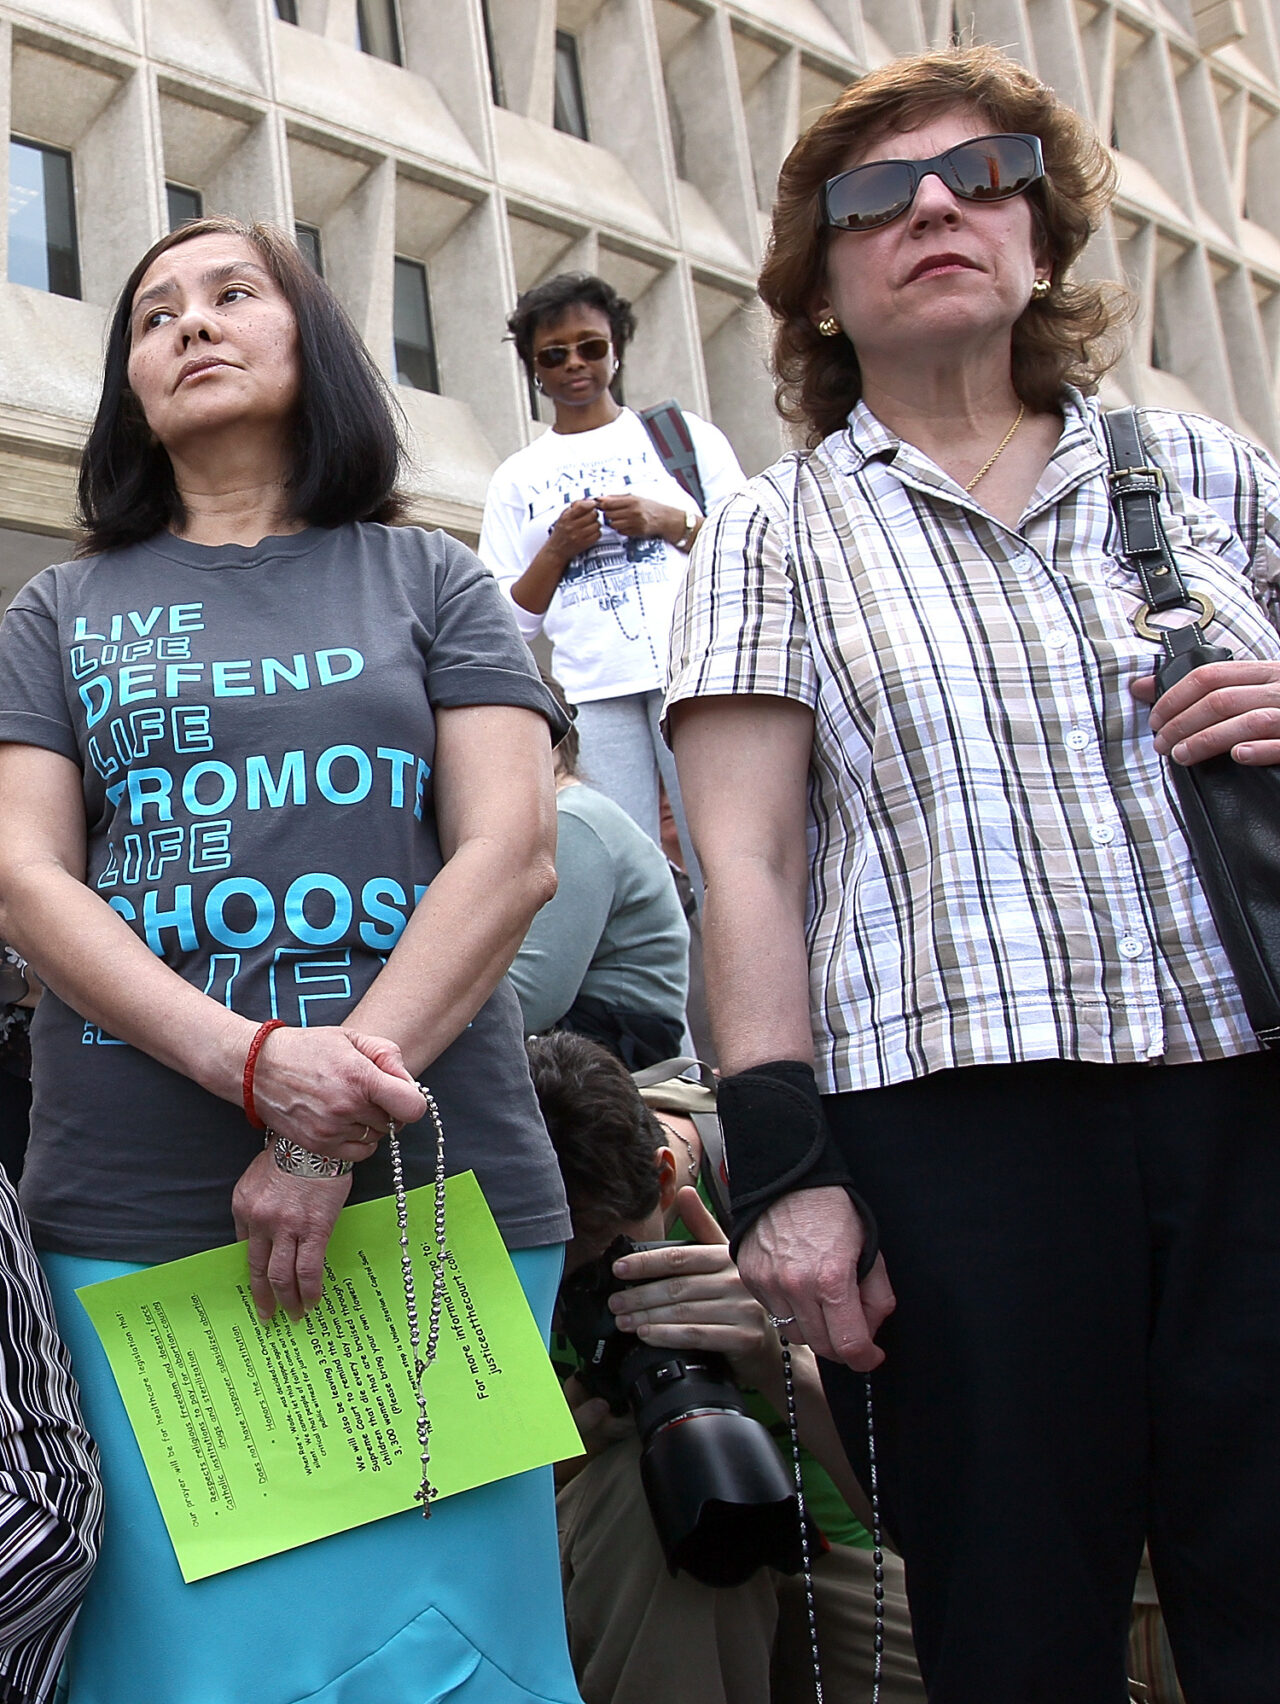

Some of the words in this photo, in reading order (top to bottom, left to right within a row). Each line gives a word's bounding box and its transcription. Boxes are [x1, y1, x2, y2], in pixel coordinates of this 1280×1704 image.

[74, 602, 205, 642] LIVE
[70, 637, 191, 680] LIFE
[78, 647, 365, 728] DEFEND
[88, 706, 214, 777] LIFE
[98, 820, 231, 889] LIFE
[358, 1250, 369, 1266] South
[420, 1242, 432, 1257] to:
[364, 1266, 378, 1288] Capitol
[332, 1284, 350, 1316] through
[342, 1278, 363, 1311] flowers)
[115, 1310, 128, 1329] that:
[140, 1304, 155, 1325] force
[241, 1295, 257, 1326] community
[379, 1298, 392, 1322] Station
[446, 1250, 502, 1375] justiceatthecourt.com
[263, 1325, 272, 1339] Tha
[276, 1328, 282, 1336] to
[284, 1324, 292, 1337] this
[314, 1306, 330, 1337] Justice
[332, 1317, 345, 1339] from
[359, 1314, 370, 1330] own
[150, 1326, 169, 1359] doesn't
[152, 1301, 186, 1368] abortion-causing
[254, 1326, 268, 1356] Christian
[278, 1338, 287, 1348] out
[290, 1338, 296, 1346] on
[345, 1319, 364, 1352] bruised
[366, 1334, 380, 1354] your
[389, 1324, 400, 1343] Union
[126, 1332, 146, 1375] legislation
[203, 1328, 229, 1373] subsidized
[232, 1323, 258, 1378] Constitution.
[284, 1349, 294, 1366] come
[293, 1347, 307, 1369] justice
[310, 1338, 327, 1365] 3,330
[327, 1340, 337, 1356] the
[342, 1342, 352, 1358] day
[462, 1344, 479, 1374] more
[162, 1362, 176, 1378] and
[278, 1360, 290, 1384] happen
[360, 1354, 370, 1370] are
[375, 1356, 388, 1380] bring
[181, 1370, 192, 1386] for
[186, 1348, 212, 1403] sterilization.
[290, 1367, 300, 1384] faith
[302, 1371, 310, 1382] for
[324, 1368, 339, 1399] leaving
[332, 1358, 350, 1389] remind
[349, 1362, 362, 1386] every
[366, 1374, 379, 1393] that
[406, 1370, 418, 1390] metro
[171, 1380, 190, 1418] freedom
[187, 1388, 199, 1405] pay
[223, 1376, 244, 1416] taxpayer
[252, 1380, 264, 1396] the
[286, 1384, 294, 1398] this
[295, 1386, 304, 1394] of
[306, 1383, 319, 1408] witness
[346, 1392, 354, 1402] to
[359, 1390, 369, 1403] die
[385, 1382, 402, 1414] (Please
[474, 1379, 489, 1400] For
[143, 1378, 164, 1426] healthcare
[194, 1407, 204, 1418] to
[280, 1396, 288, 1408] was
[300, 1395, 313, 1416] people
[336, 1402, 345, 1414] be
[376, 1396, 391, 1425] women
[204, 1405, 219, 1422] and
[259, 1398, 276, 1431] Honors
[295, 1410, 307, 1432] cannot
[308, 1417, 317, 1432] that
[316, 1409, 328, 1428] public
[350, 1406, 364, 1430] Court
[365, 1407, 378, 1426] that
[160, 1428, 170, 1442] for
[239, 1418, 253, 1441] have
[342, 1416, 352, 1434] also
[185, 1421, 205, 1458] religious
[198, 1420, 223, 1471] institutions
[214, 1424, 228, 1450] drugs
[304, 1433, 312, 1445] We
[312, 1432, 326, 1456] critical
[347, 1437, 360, 1452] will
[374, 1429, 392, 1466] children
[386, 1428, 402, 1456] 3,300
[166, 1446, 174, 1458] be
[246, 1442, 259, 1458] not
[296, 1442, 305, 1455] Roe
[310, 1448, 320, 1468] silent.
[362, 1433, 380, 1472] Supreme
[170, 1460, 181, 1473] will
[254, 1460, 268, 1484] Does
[302, 1455, 312, 1476] When
[356, 1455, 366, 1472] We
[200, 1460, 220, 1502] Respects
[217, 1473, 236, 1510] Catholic
[178, 1478, 195, 1508] prayer
